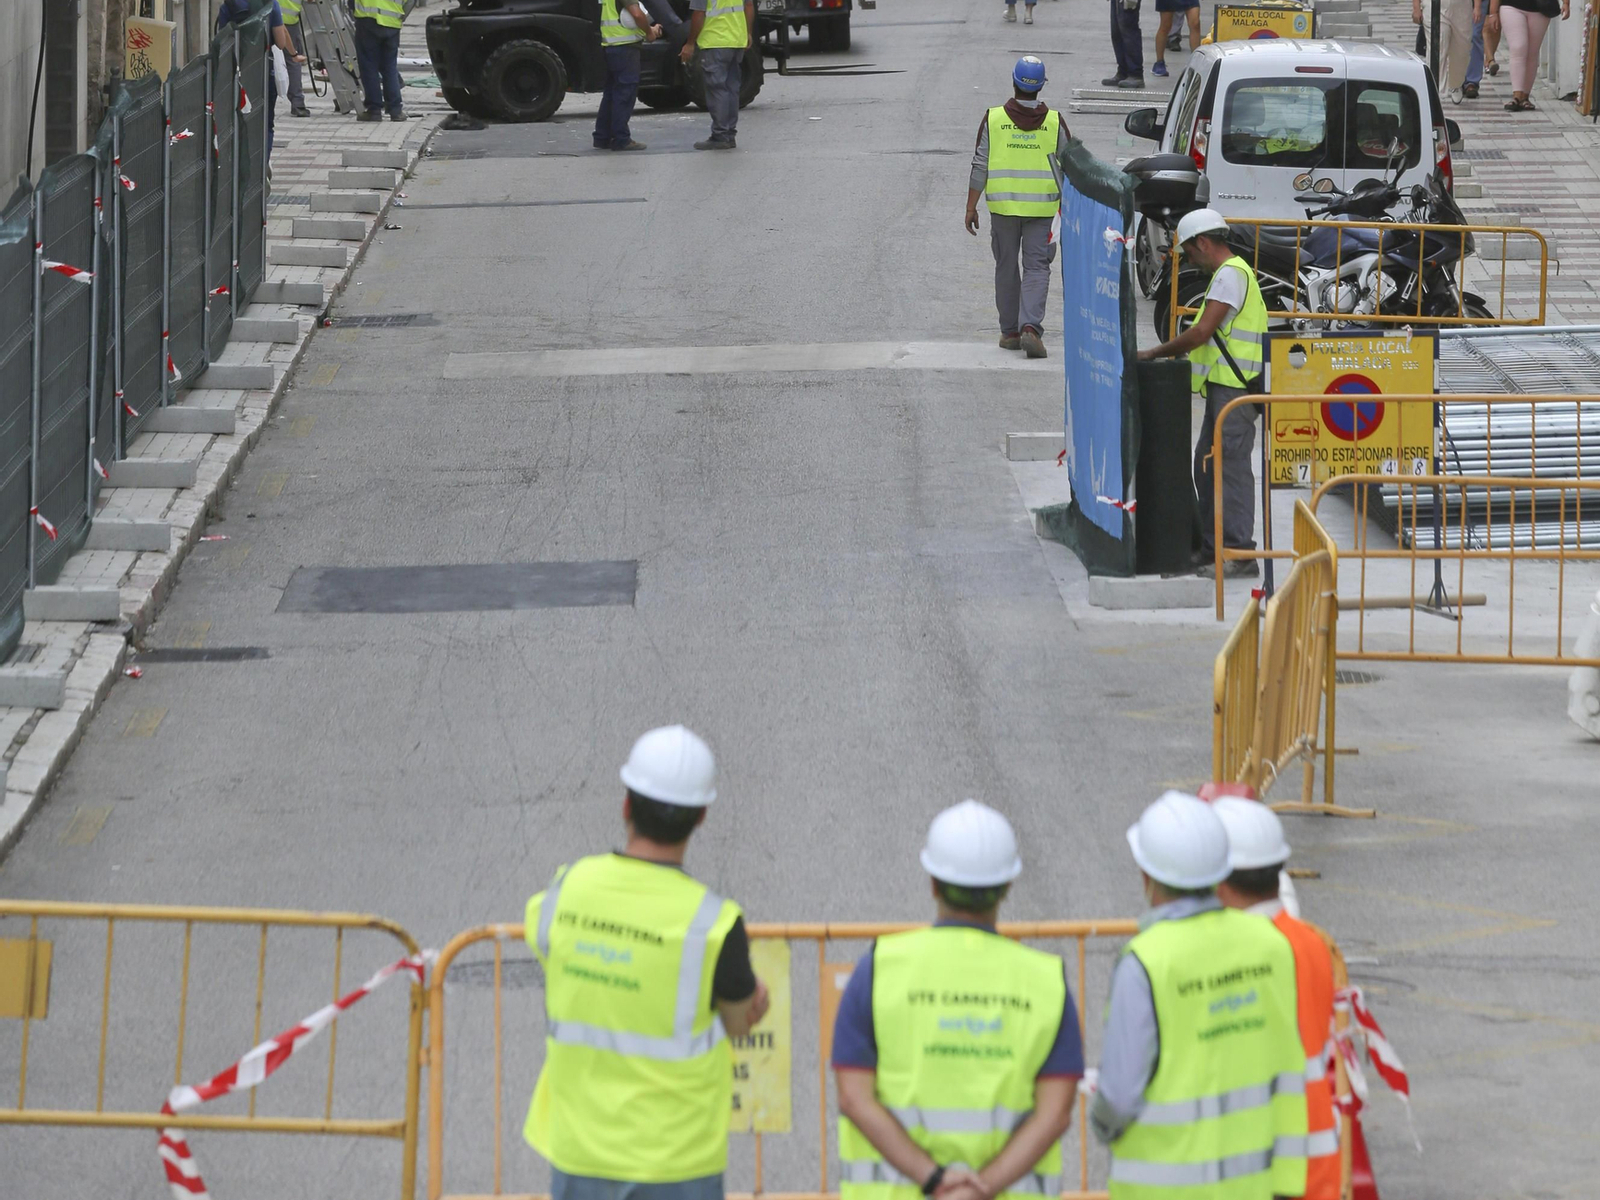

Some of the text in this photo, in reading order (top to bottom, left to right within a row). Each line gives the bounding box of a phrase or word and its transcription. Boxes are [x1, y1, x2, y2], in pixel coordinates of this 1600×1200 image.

[1220, 9, 1286, 20] POLICIA LOCAL
[1232, 18, 1269, 27] MALAGA
[1311, 341, 1365, 355] POLICIA
[1274, 448, 1328, 463] PROHIBDO
[1274, 465, 1293, 481] LAS
[1299, 464, 1309, 480] 7
